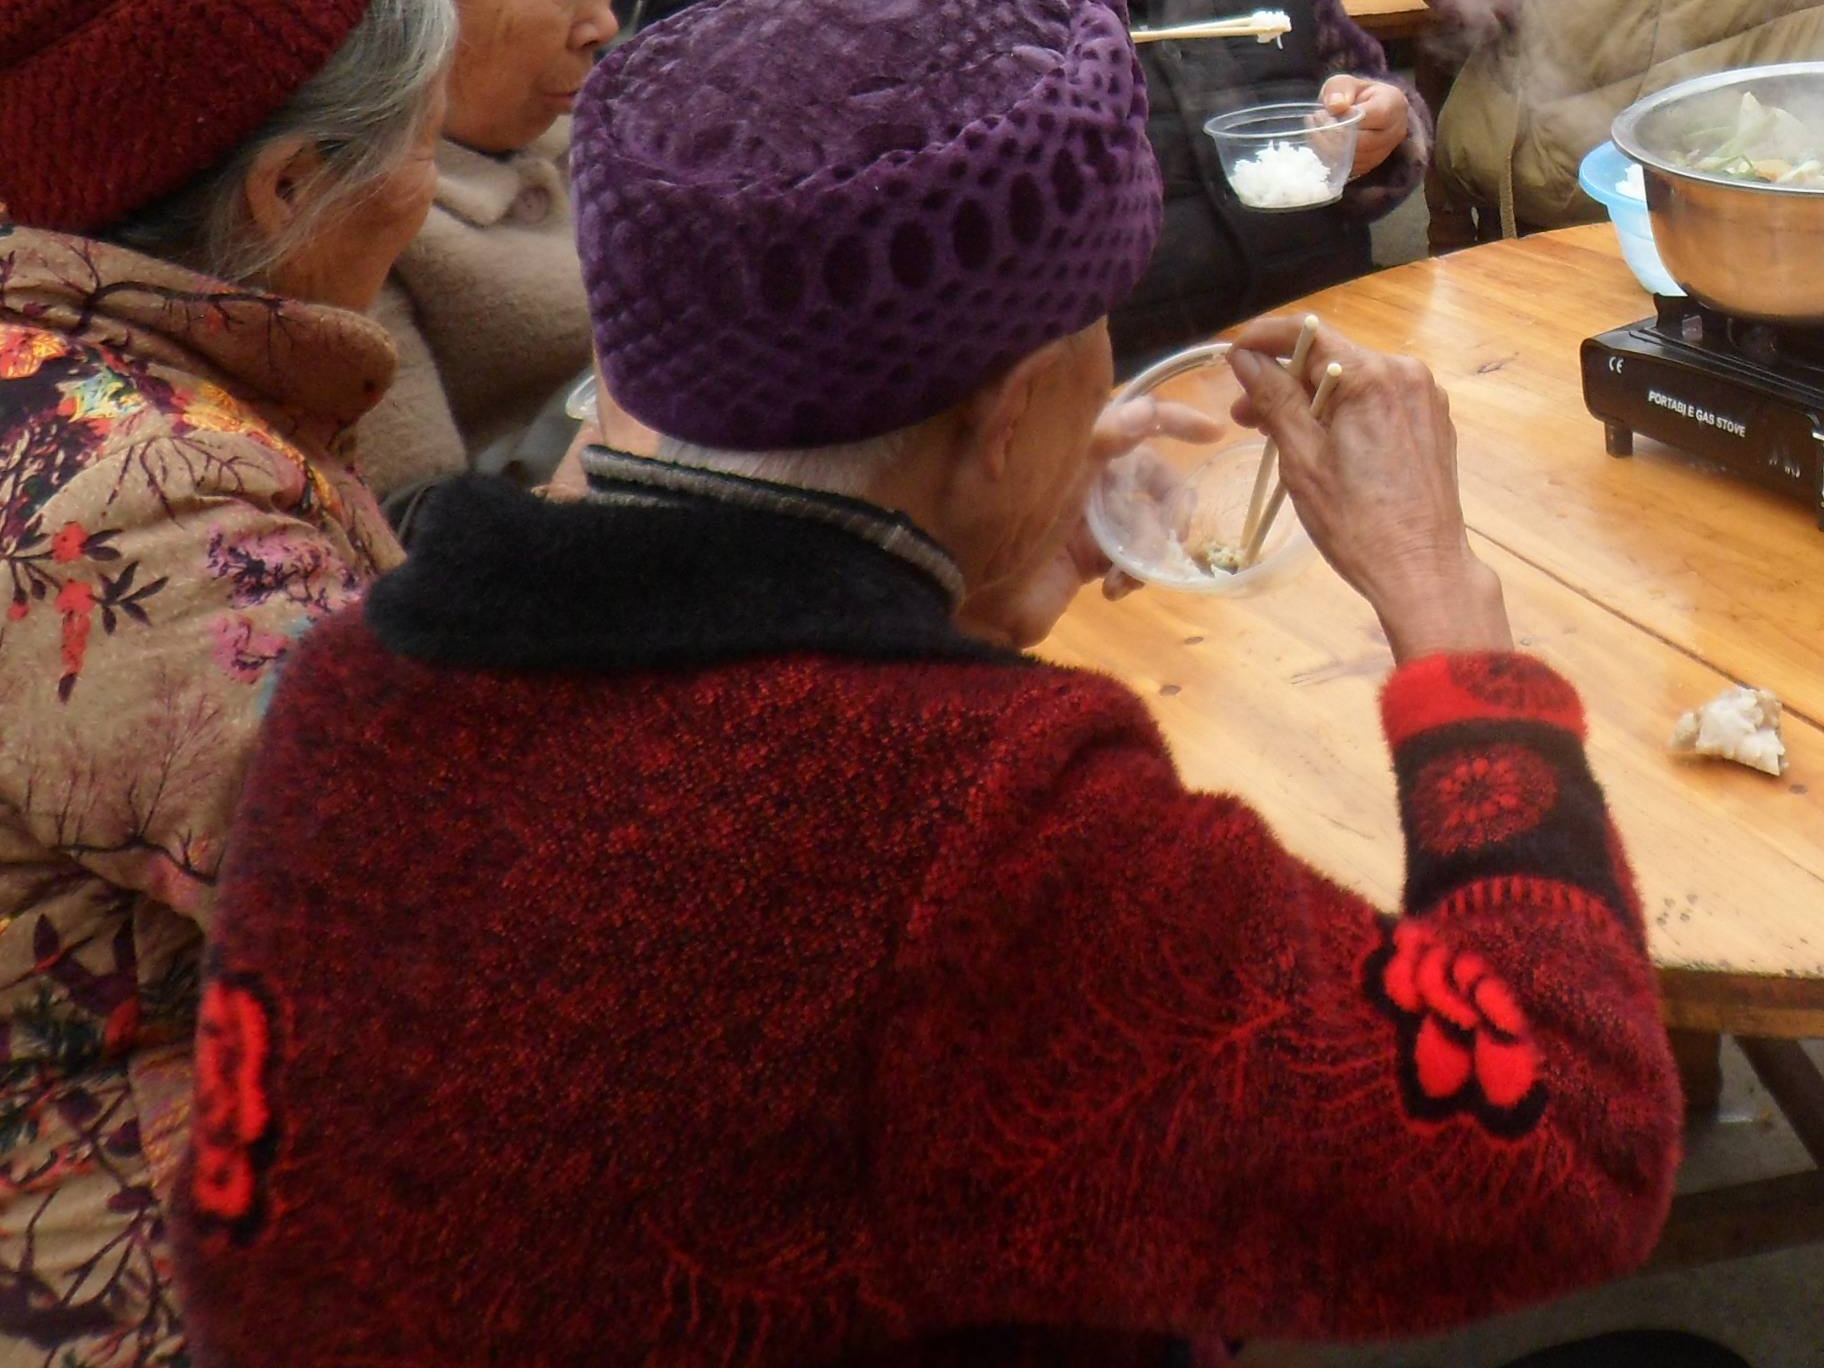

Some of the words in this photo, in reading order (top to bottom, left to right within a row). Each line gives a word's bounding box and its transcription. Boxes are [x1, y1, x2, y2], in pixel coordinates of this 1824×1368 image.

[1608, 356, 1625, 374] CE
[1695, 408, 1715, 426] GAS
[1716, 416, 1747, 438] STOVE
